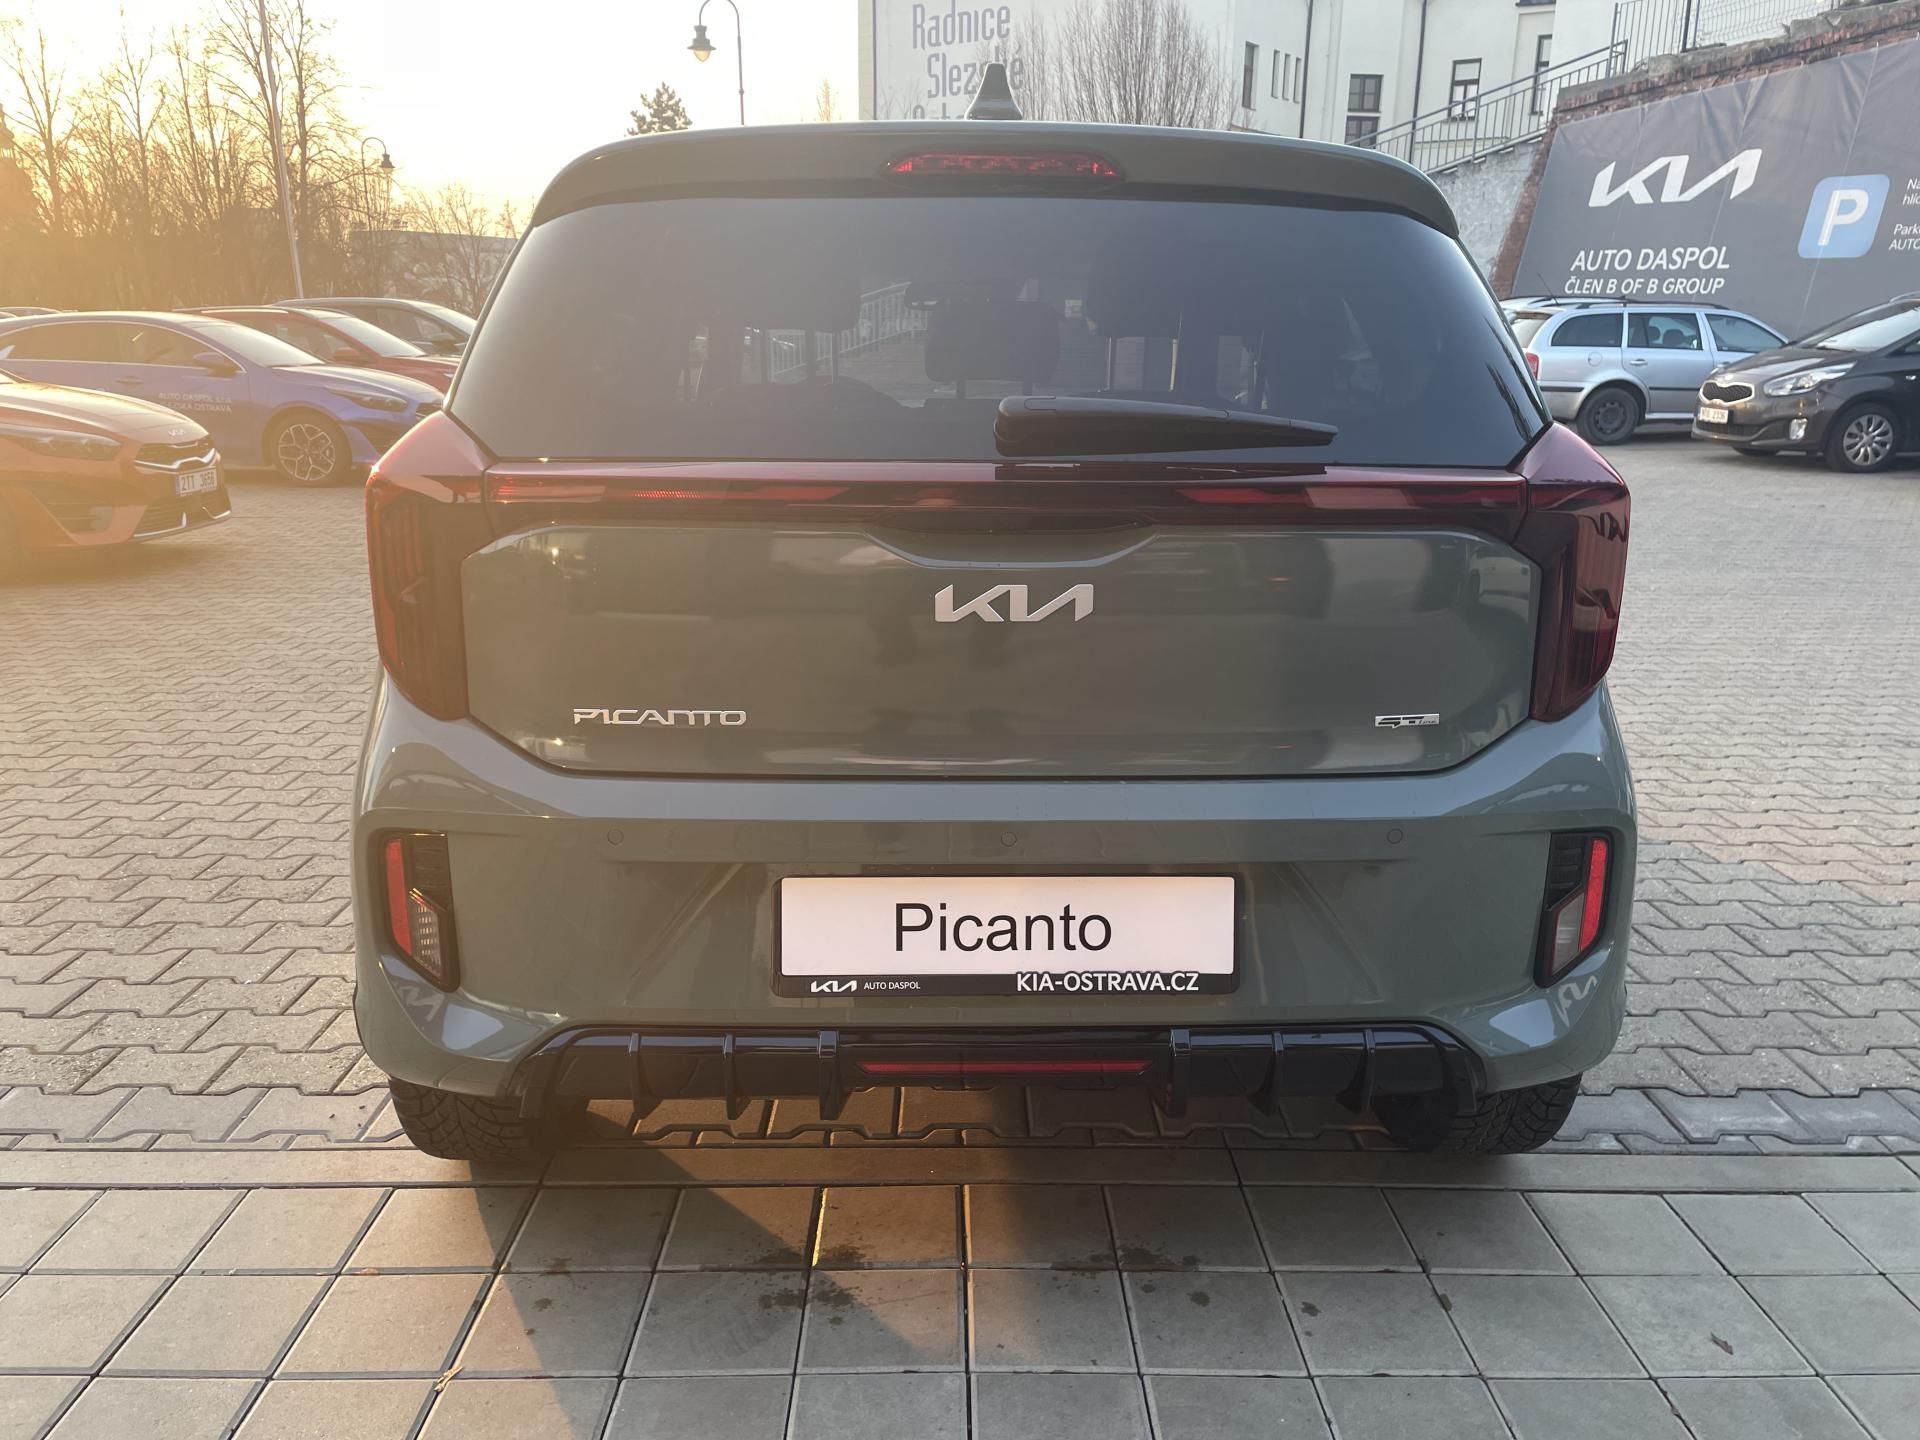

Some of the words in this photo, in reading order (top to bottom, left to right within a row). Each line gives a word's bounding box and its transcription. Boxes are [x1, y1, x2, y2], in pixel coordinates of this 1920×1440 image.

[912, 0, 1010, 50] Radnice
[1588, 148, 1762, 207] KIA
[1817, 188, 1869, 246] P
[1894, 223, 1920, 235] Park
[1570, 250, 1632, 271] AUTO
[1636, 246, 1730, 270] DASPOL
[1564, 275, 1603, 294] ČLEN
[1606, 278, 1618, 294] B
[1621, 278, 1645, 294] OF
[1646, 278, 1659, 294] B
[1662, 277, 1725, 294] GROUP
[935, 584, 1093, 622] KIA
[573, 708, 747, 727] PICANTO
[895, 902, 1112, 952] Picanto
[811, 980, 857, 992] KIA
[864, 981, 887, 990] AUTO
[888, 981, 921, 990] DASPOL
[1016, 973, 1200, 992] KIA-OSTRAVA.CZ
